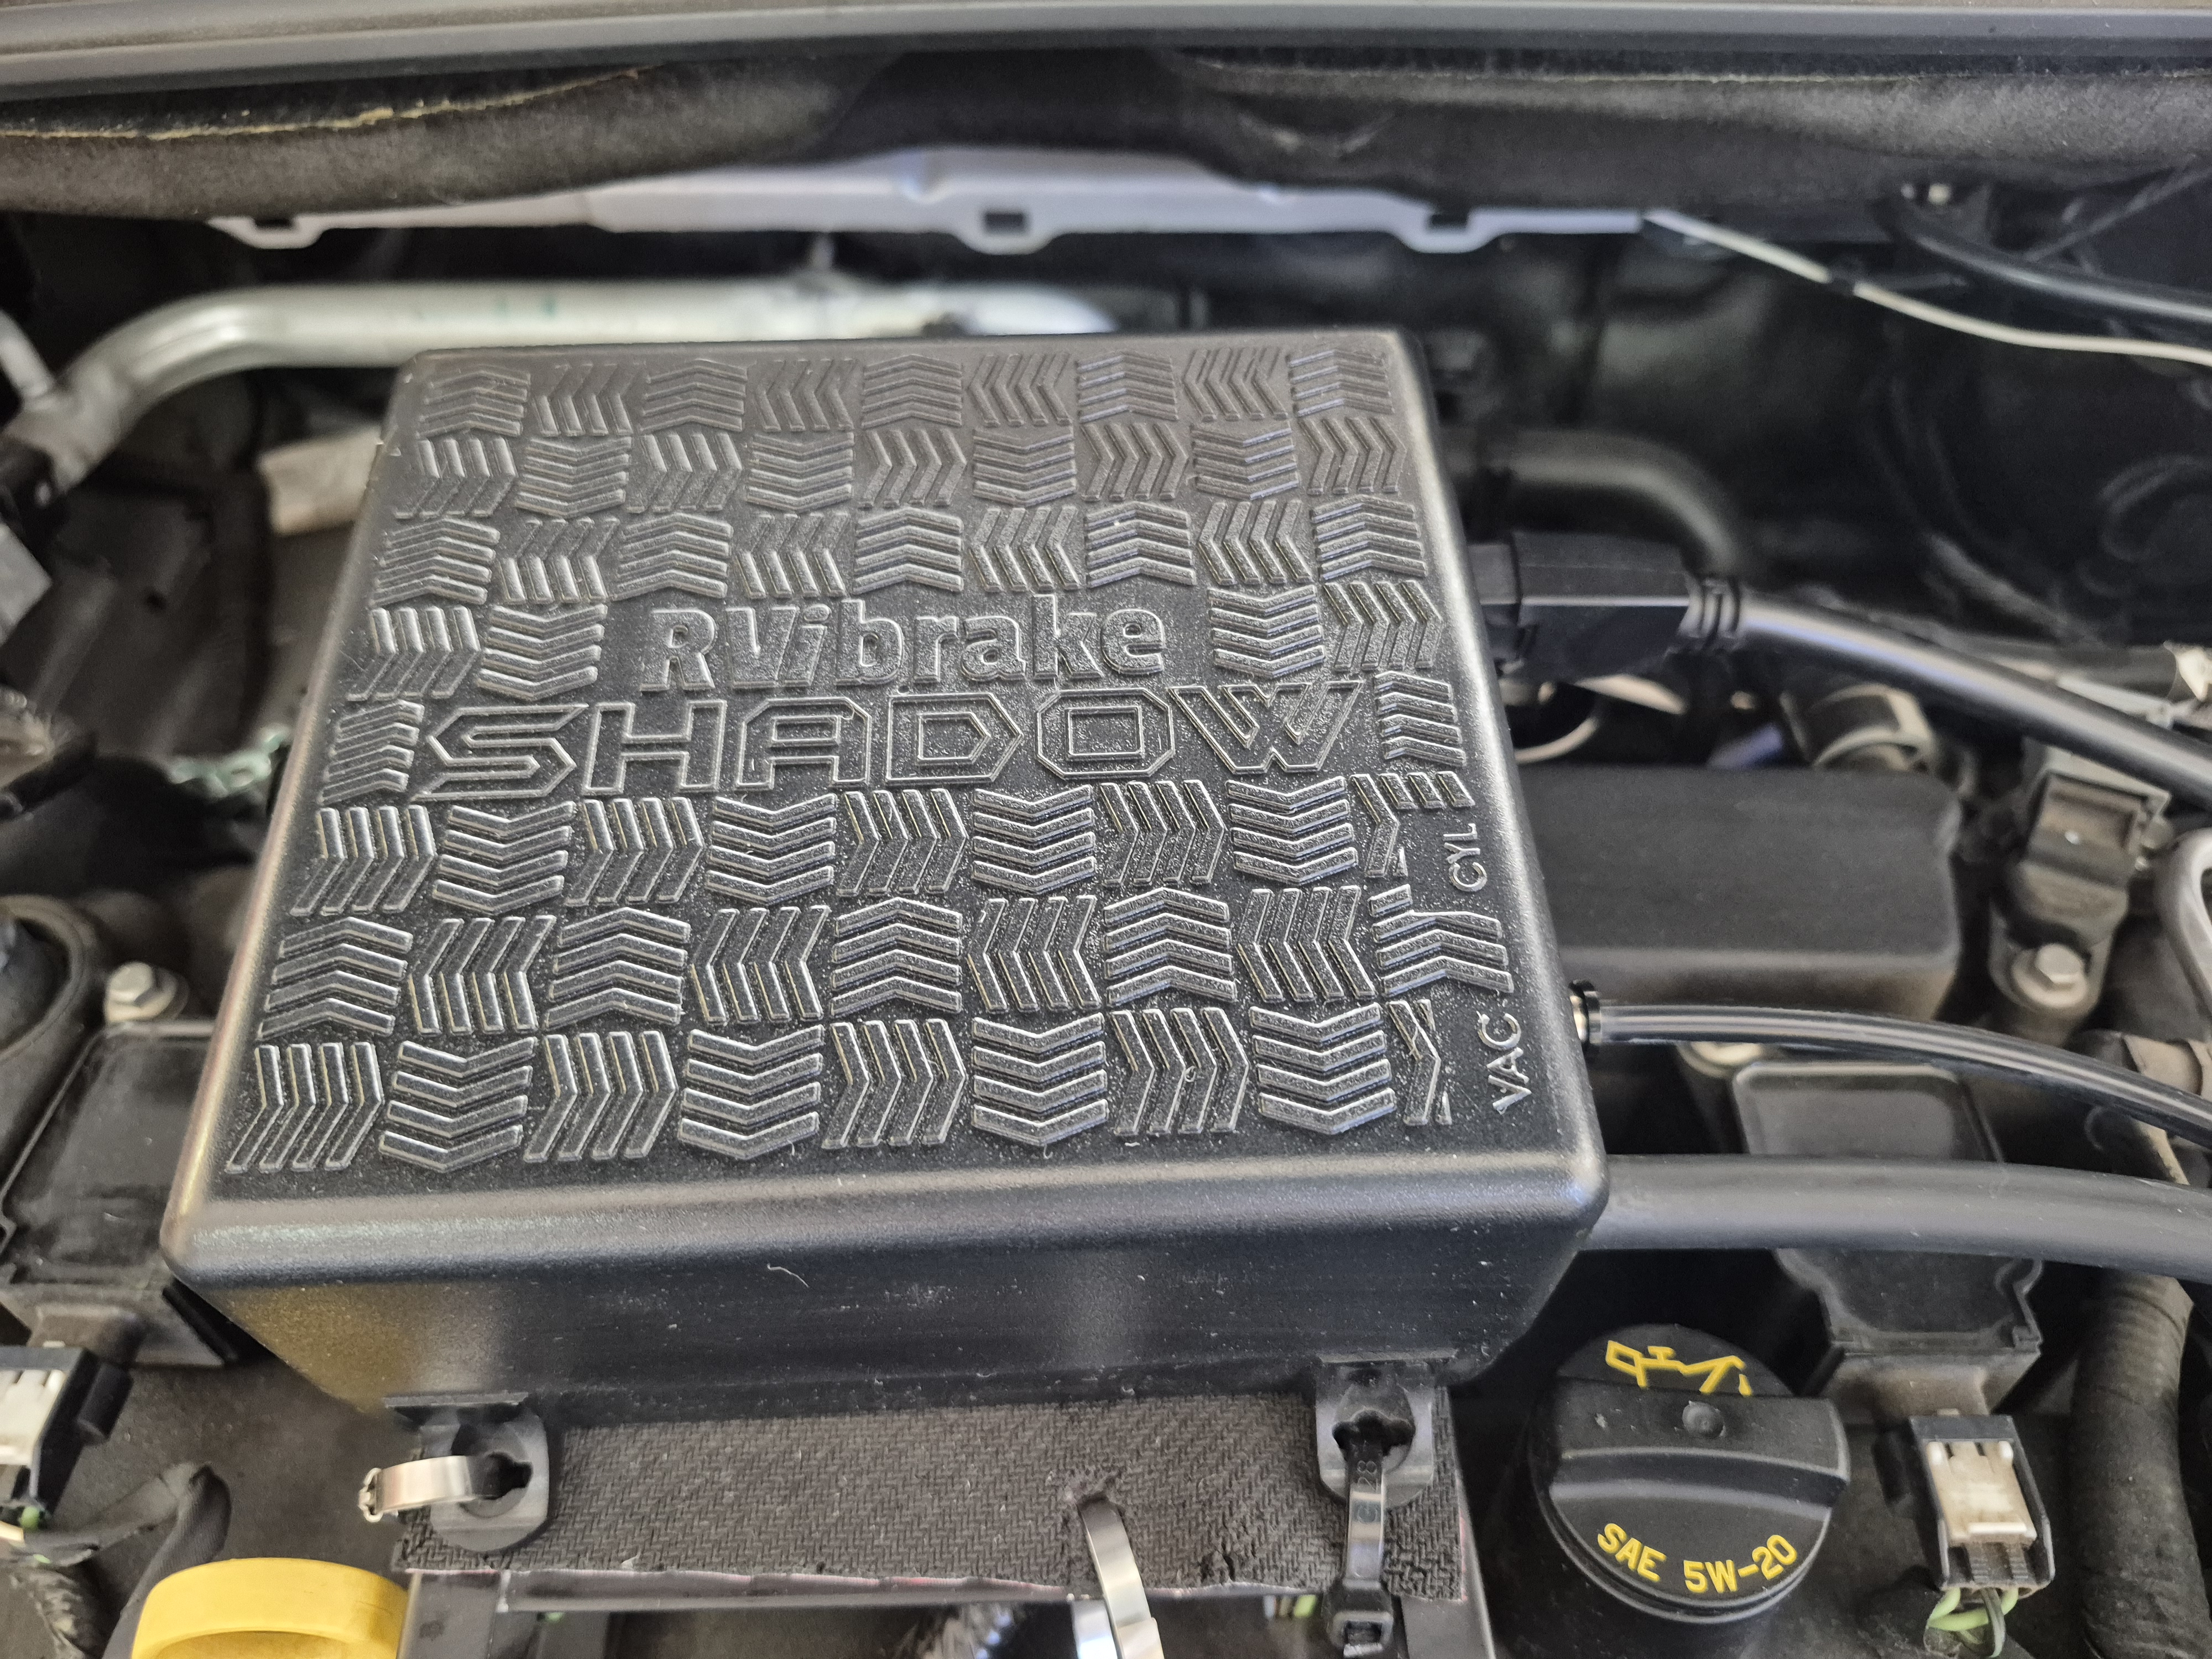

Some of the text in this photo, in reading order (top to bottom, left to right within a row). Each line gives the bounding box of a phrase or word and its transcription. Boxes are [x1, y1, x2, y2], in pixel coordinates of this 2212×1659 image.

[640, 593, 1166, 692] RVibrake
[410, 680, 1365, 801] SHADOW
[1443, 823, 1488, 892] CYL
[1478, 1012, 1532, 1114] VAC
[1597, 1523, 1797, 1593] SAE 5W-20
